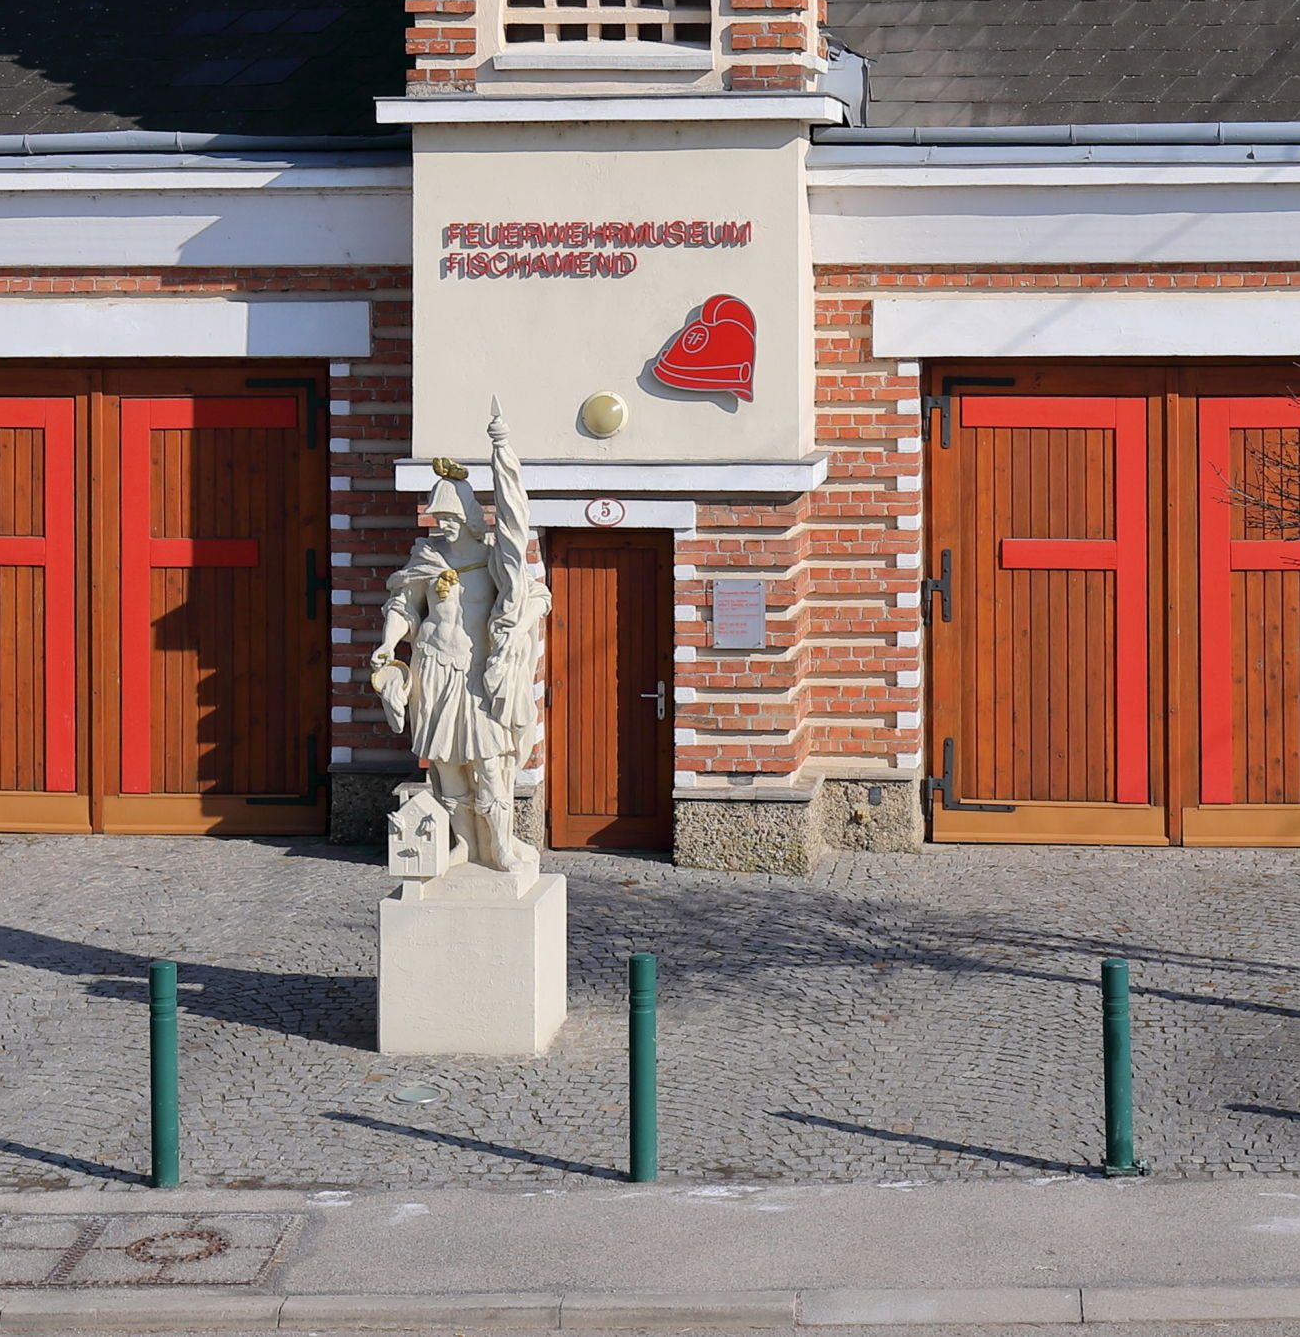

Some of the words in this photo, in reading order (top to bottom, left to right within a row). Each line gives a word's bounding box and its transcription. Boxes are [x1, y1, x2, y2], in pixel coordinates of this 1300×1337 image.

[448, 221, 752, 244] FEUERWEHRMUSEUM
[448, 251, 638, 274] FISCHAMEND
[601, 501, 611, 518] 5
